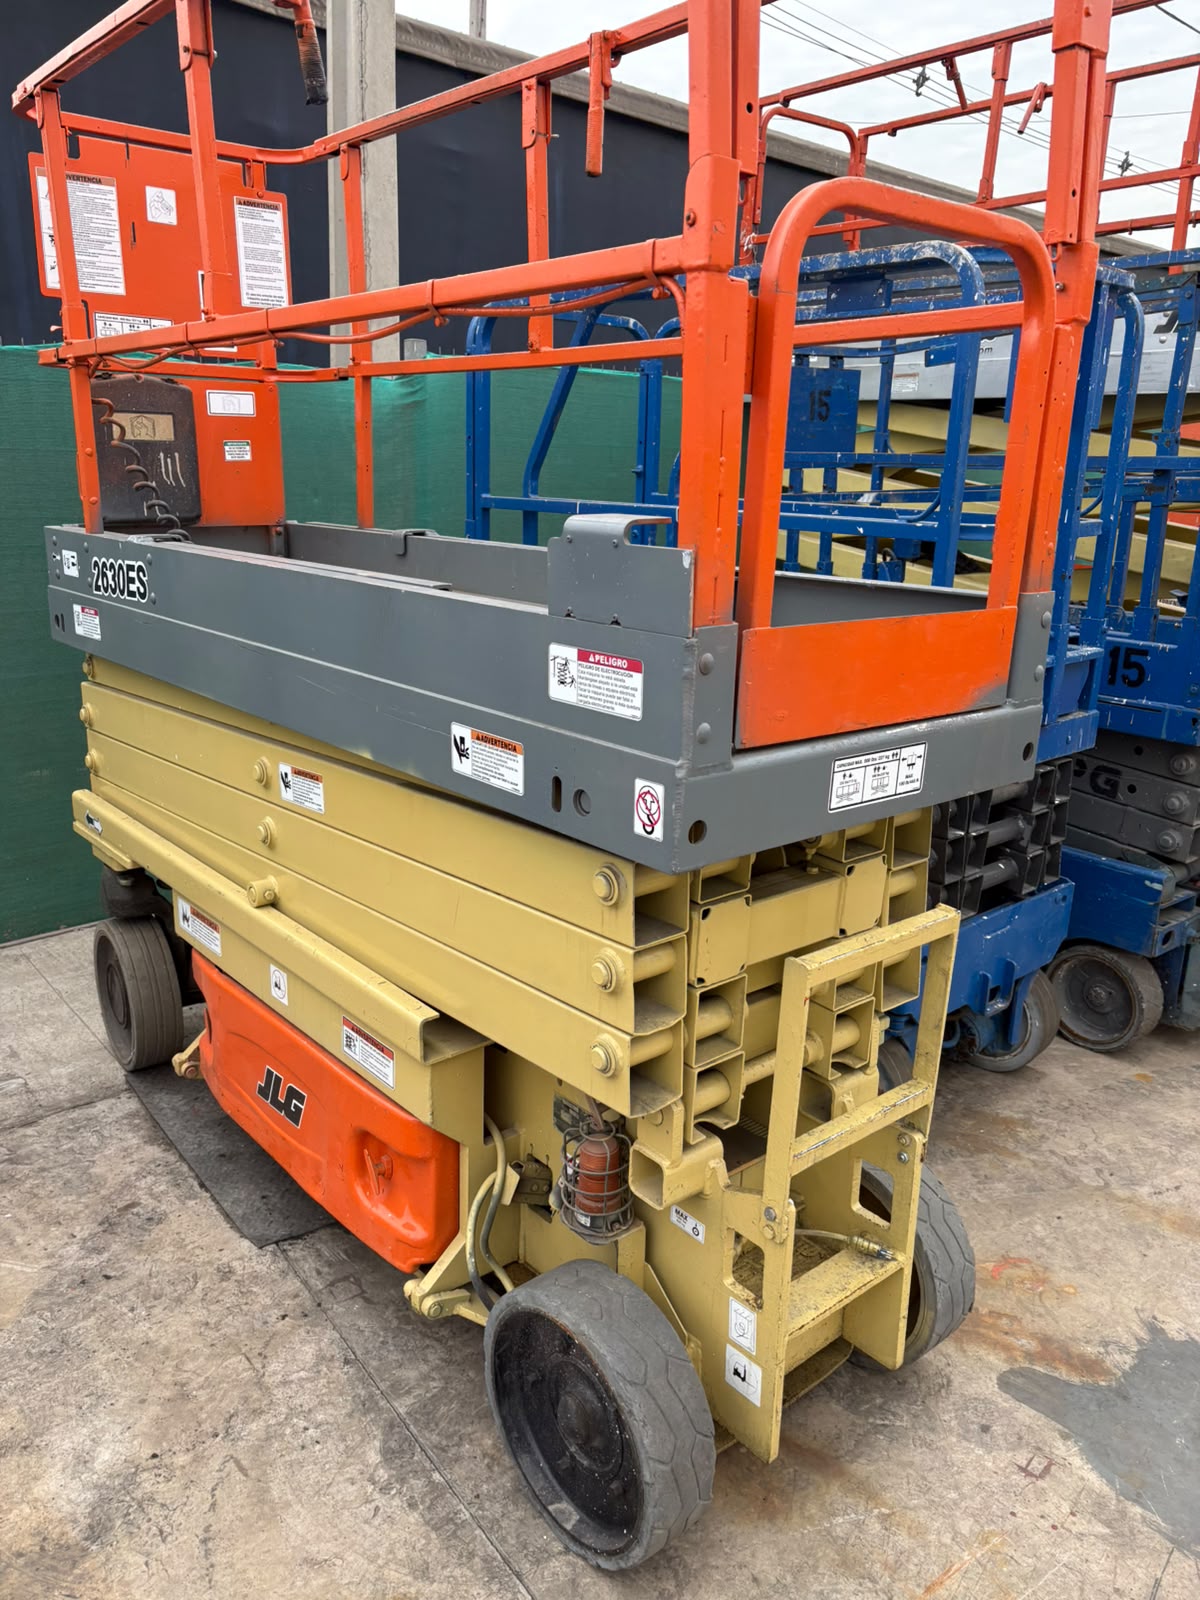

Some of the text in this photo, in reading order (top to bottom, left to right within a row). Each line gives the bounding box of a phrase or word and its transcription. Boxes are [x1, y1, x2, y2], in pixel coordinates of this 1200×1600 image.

[242, 200, 279, 210] ADVERTENCIA
[809, 388, 831, 422] 15
[92, 559, 148, 602] 2630ES
[595, 654, 628, 669] PELIGRO
[1107, 646, 1149, 688] 15
[481, 735, 517, 752] ADVERTENCIA
[256, 1065, 307, 1128] JLG
